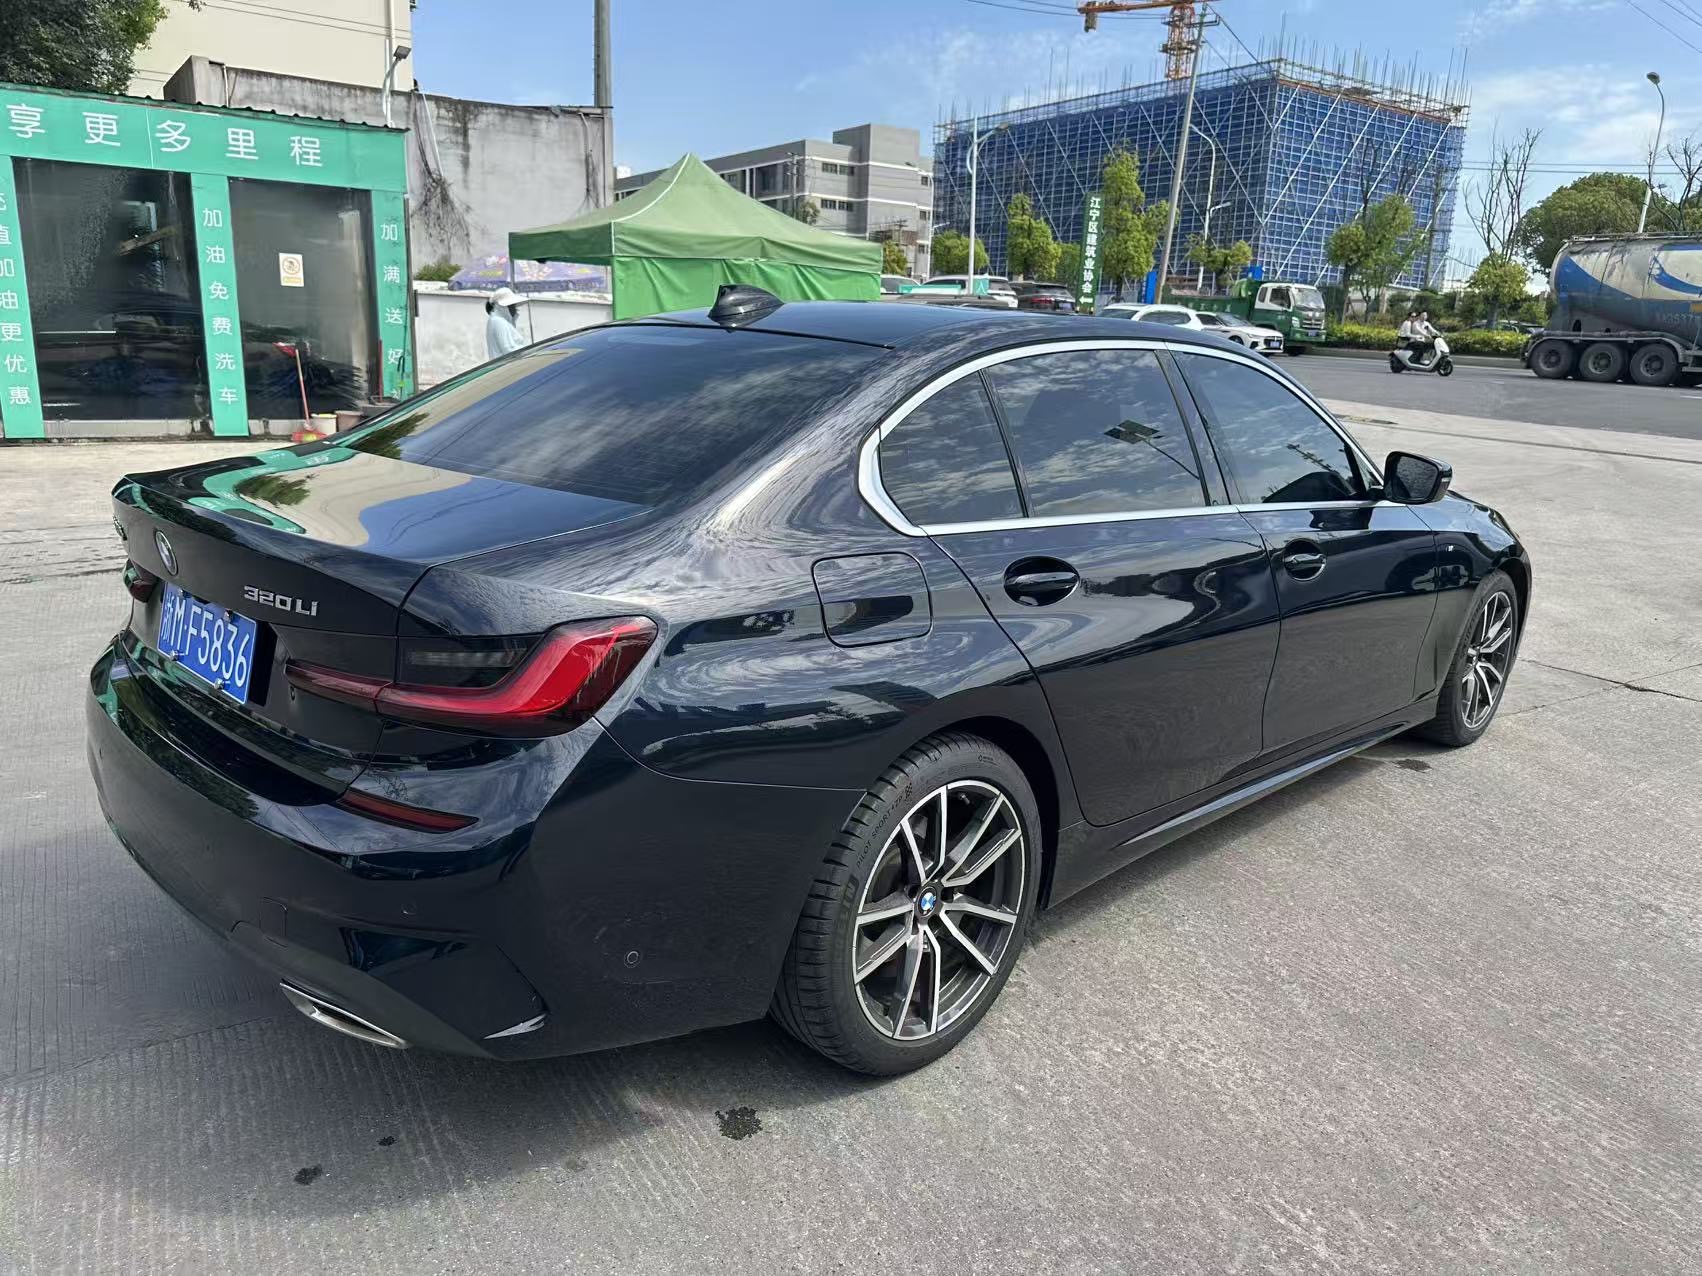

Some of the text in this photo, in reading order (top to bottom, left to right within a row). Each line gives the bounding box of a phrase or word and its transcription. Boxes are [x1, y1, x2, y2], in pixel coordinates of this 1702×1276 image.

[7, 103, 323, 167] 享更多里程
[1082, 196, 1101, 294] 江宁区建筑业协会
[202, 207, 239, 405] 加油免费洗车
